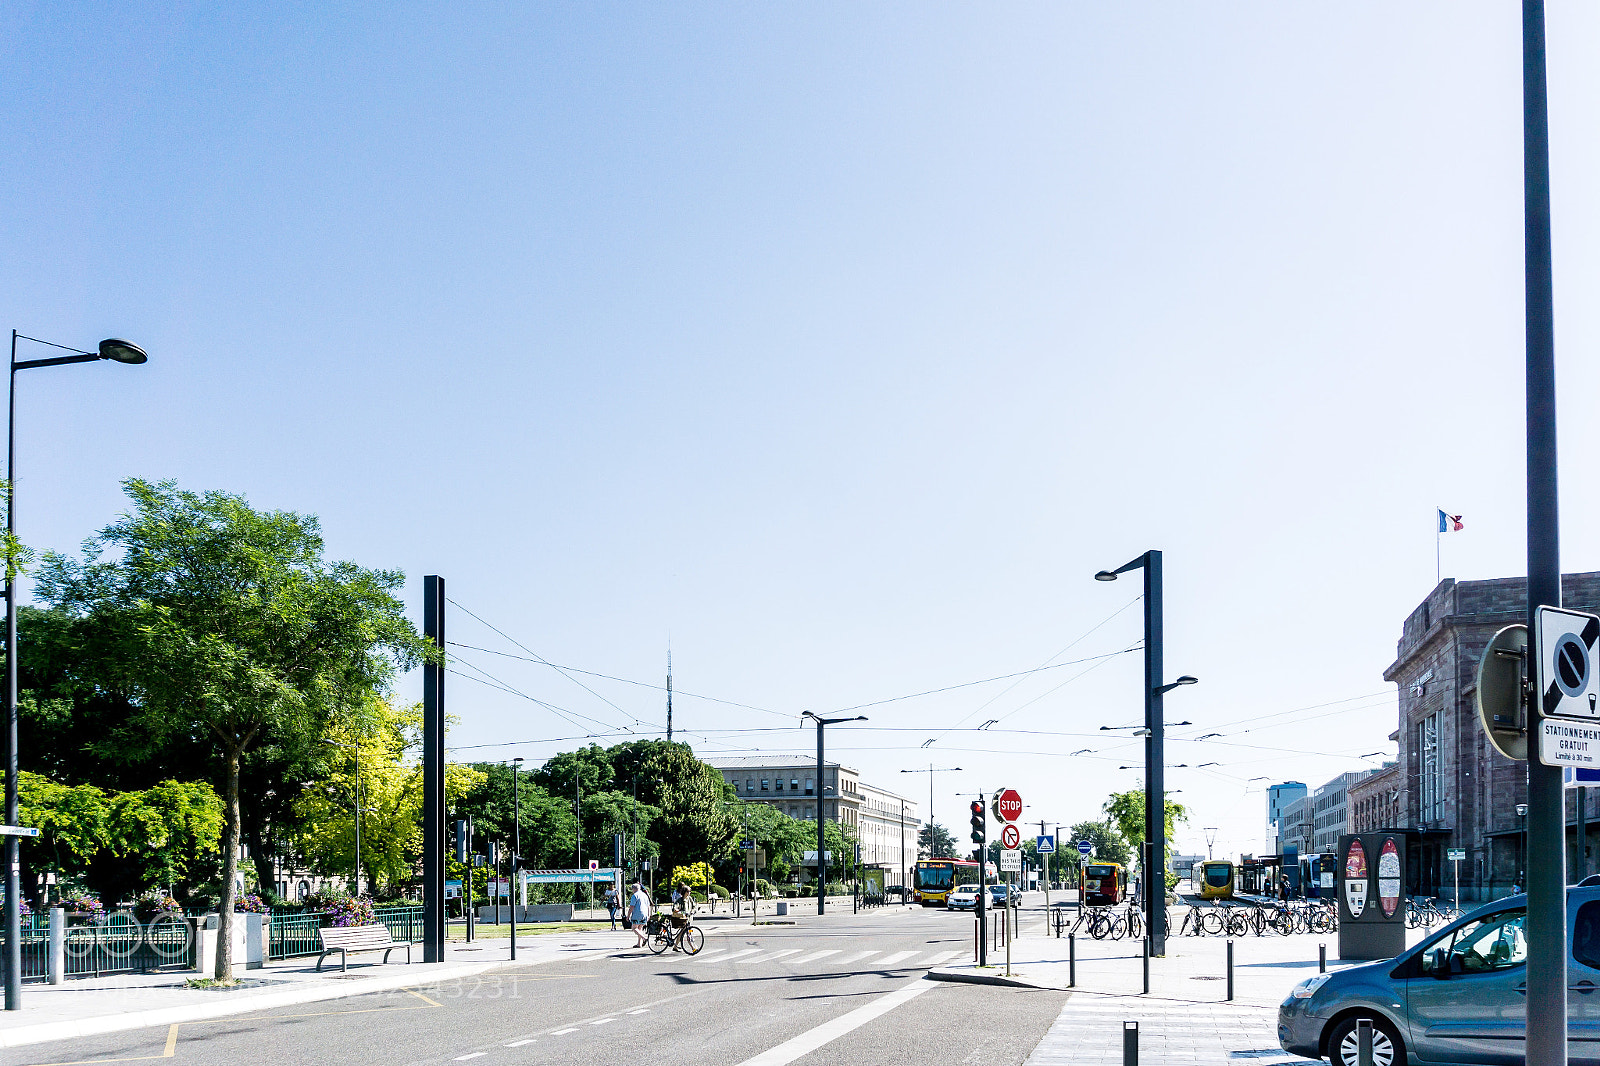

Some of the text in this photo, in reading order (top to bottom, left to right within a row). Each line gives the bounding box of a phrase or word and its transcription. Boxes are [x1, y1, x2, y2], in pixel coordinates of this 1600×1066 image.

[1560, 740, 1588, 751] GRATUIT
[1556, 752, 1571, 760] Limité
[1001, 800, 1021, 811] STOP
